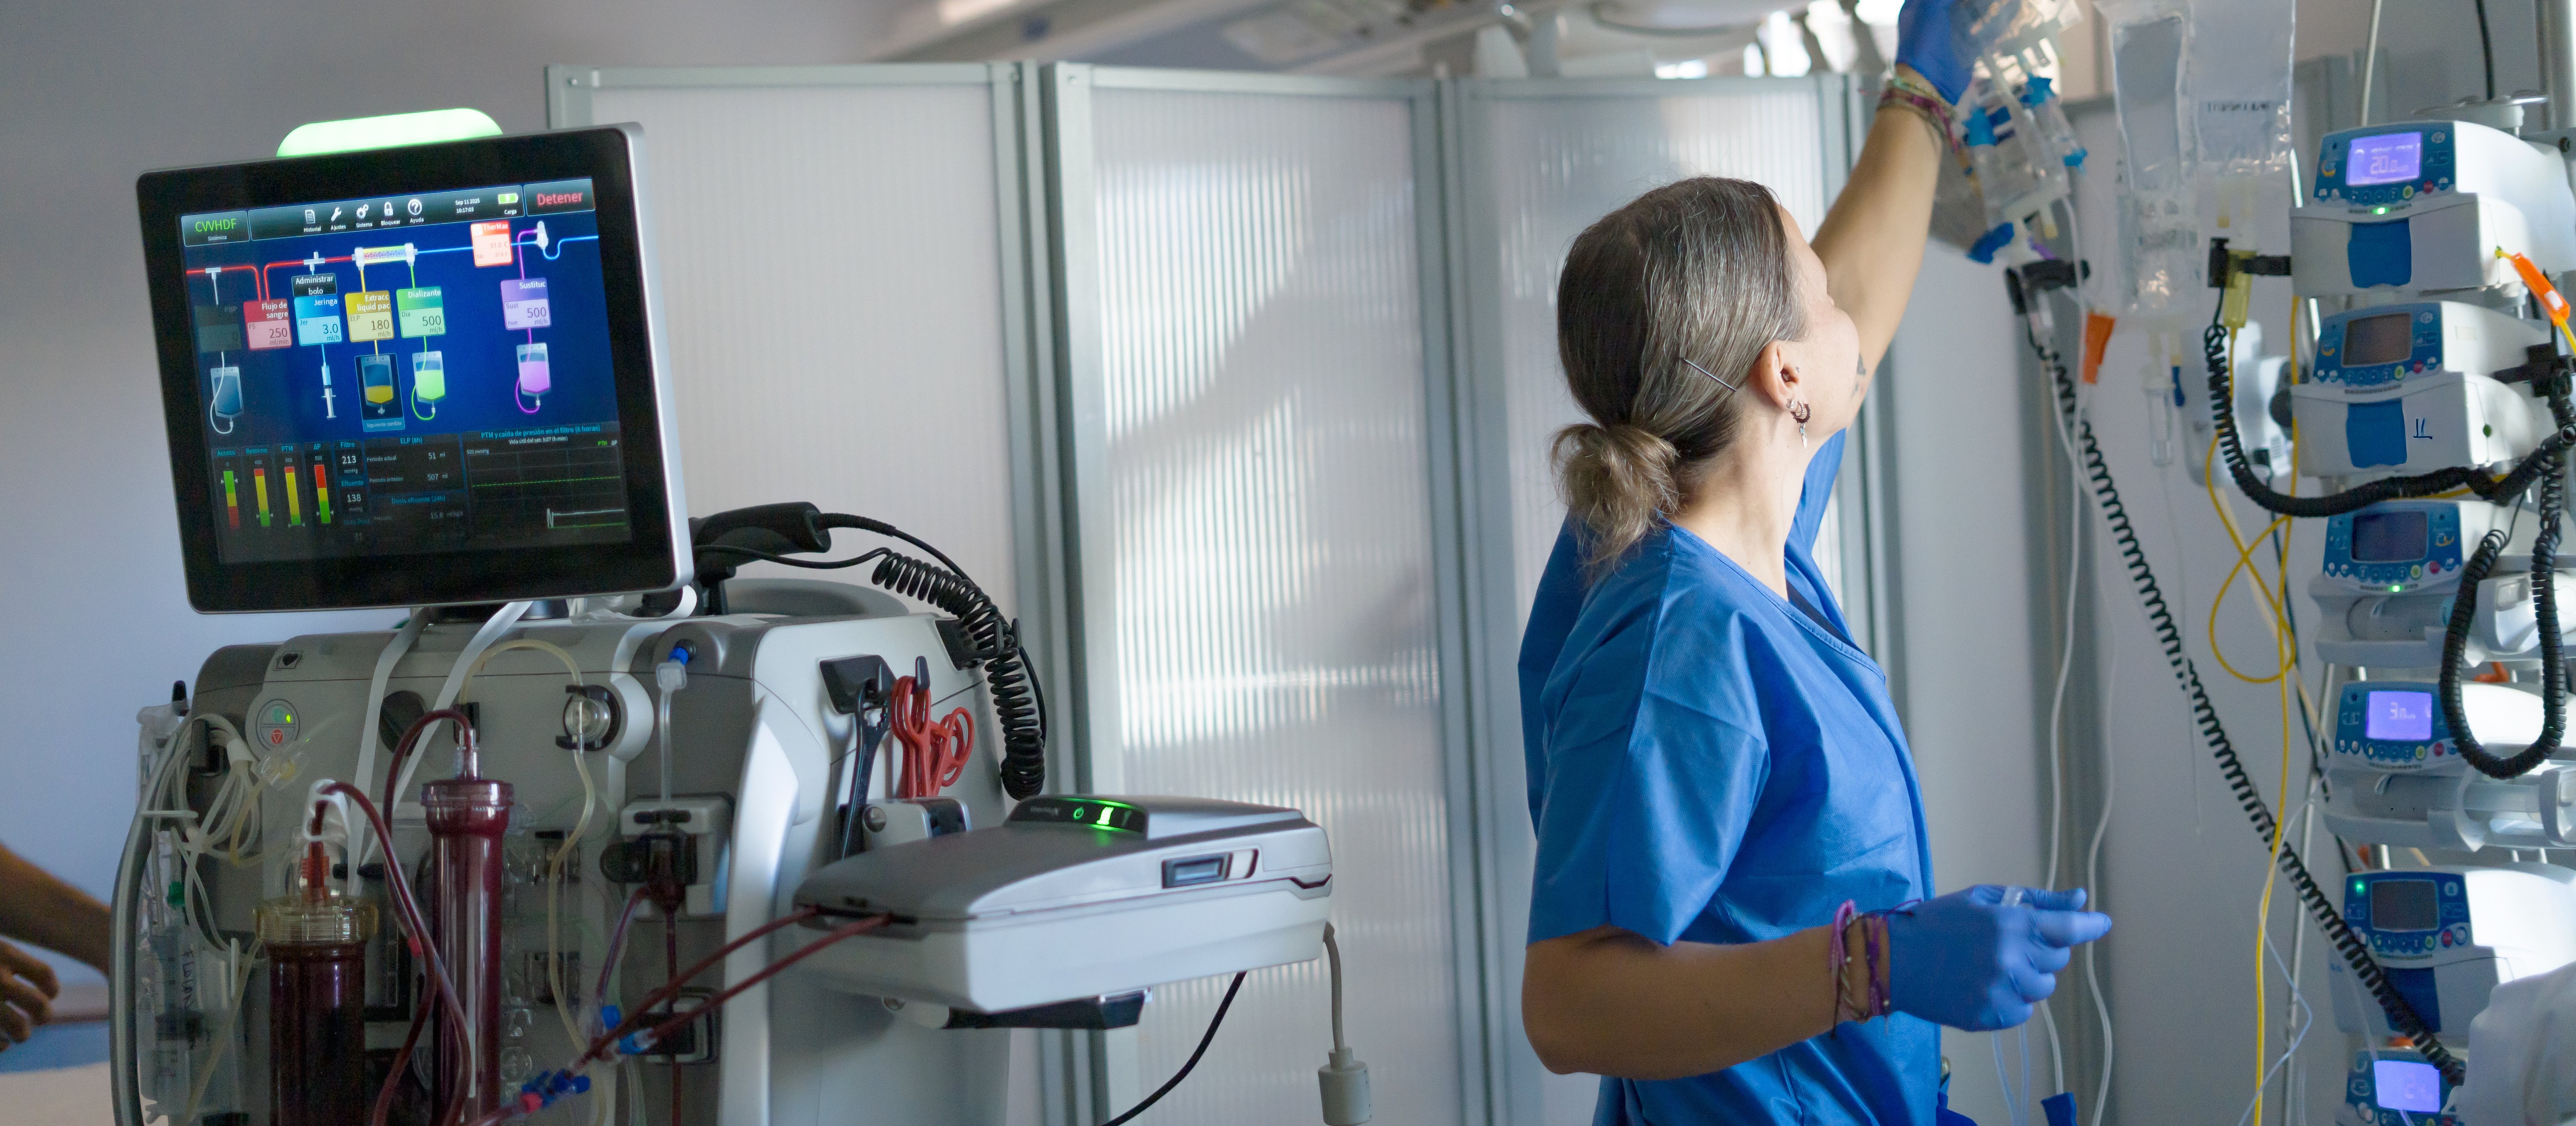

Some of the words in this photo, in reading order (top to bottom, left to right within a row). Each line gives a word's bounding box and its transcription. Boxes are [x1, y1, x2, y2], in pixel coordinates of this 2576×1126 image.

[537, 192, 583, 206] Detener
[295, 275, 333, 285] Administrar
[519, 281, 546, 289] Sustituc
[408, 289, 441, 298] Dializante
[261, 303, 277, 311] Flujo
[314, 298, 337, 307] Jeringa
[266, 311, 288, 319] sangre
[527, 307, 547, 318] 500
[371, 320, 389, 330] 180
[422, 316, 441, 326] 500
[269, 328, 288, 338] 250
[322, 324, 338, 334] 3.0
[523, 428, 545, 437] presión
[582, 425, 601, 433] horas)
[342, 455, 356, 464] 213
[347, 494, 361, 502] 138
